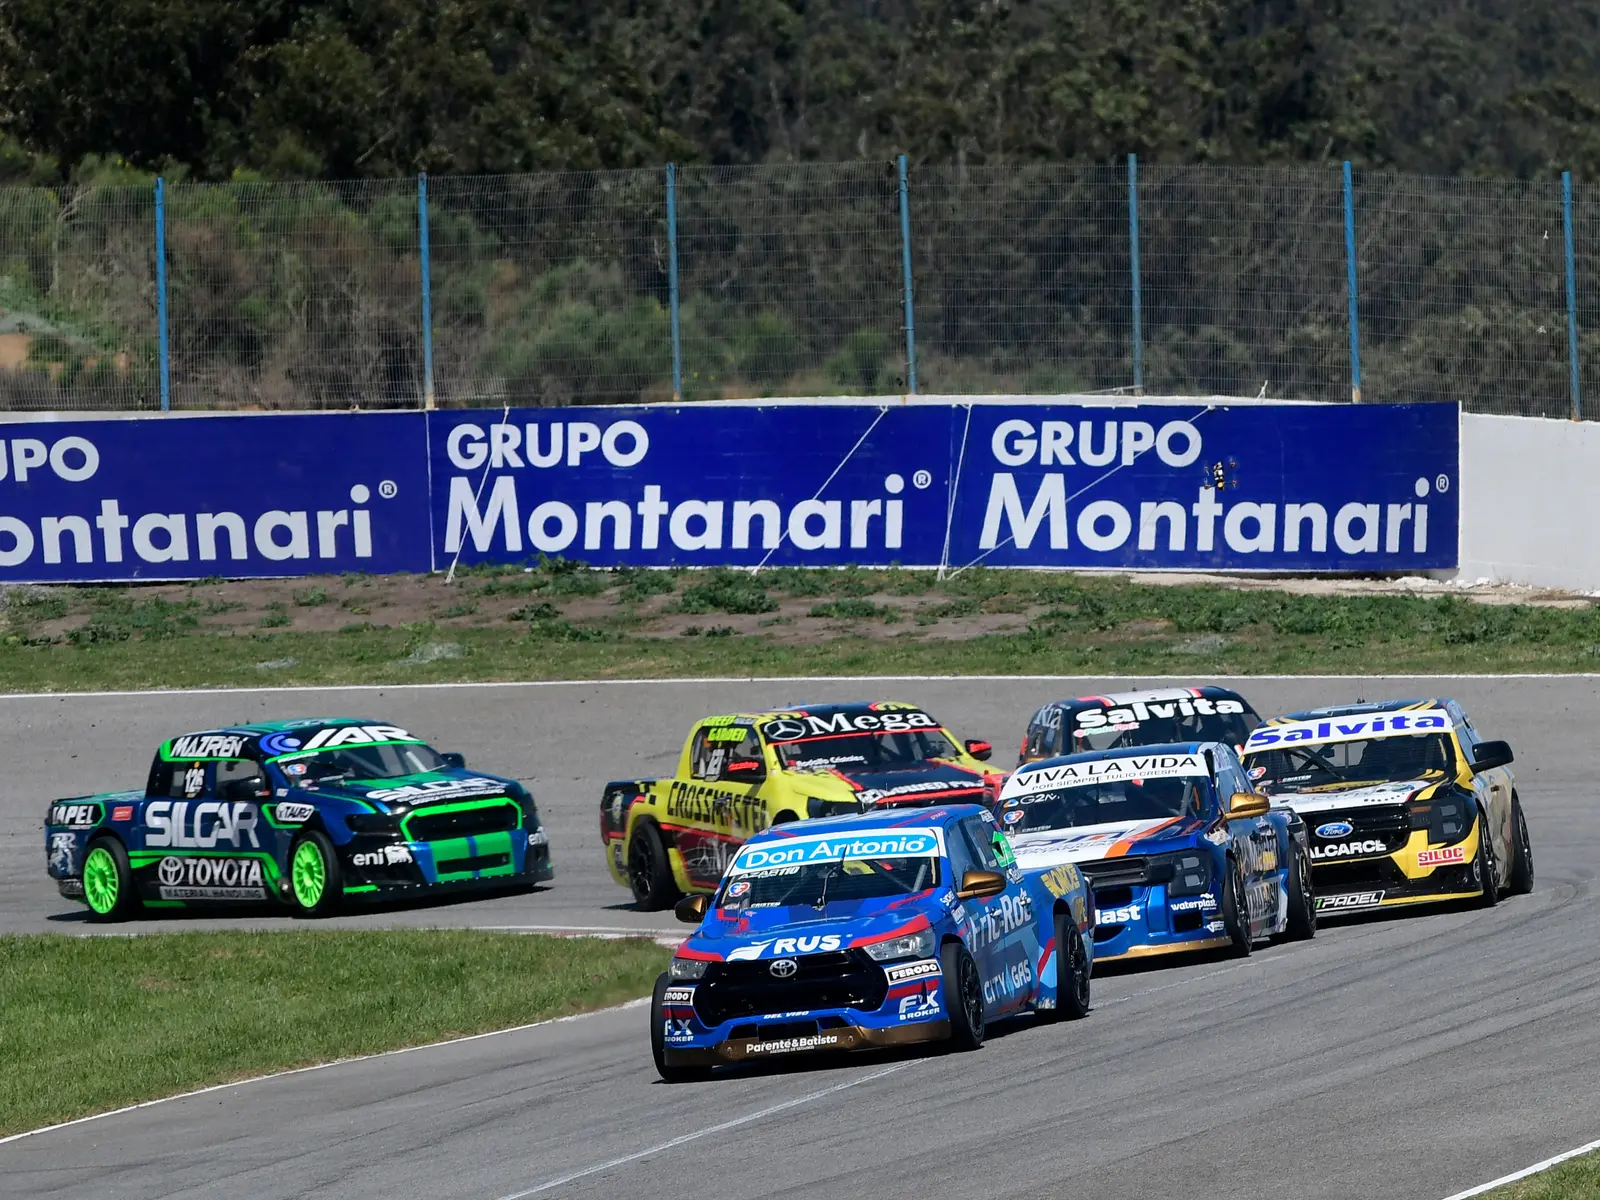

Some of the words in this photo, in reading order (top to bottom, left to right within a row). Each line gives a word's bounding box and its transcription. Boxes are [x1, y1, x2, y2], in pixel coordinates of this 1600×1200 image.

[446, 420, 649, 470] GRUPO
[991, 420, 1201, 468] GRUPO
[0, 436, 99, 482] PO
[444, 473, 903, 554] Montanari
[978, 472, 1429, 554] Montanari
[807, 712, 938, 736] Mega
[1075, 698, 1244, 729] Salvita
[1250, 715, 1445, 747] Salvita
[1016, 767, 1083, 787] VIVA
[1088, 761, 1123, 776] LA
[1131, 757, 1198, 770] VIDA
[1031, 782, 1054, 791] POR
[1056, 776, 1100, 788] SIEMPRE
[1104, 771, 1137, 781] TULIO
[1138, 768, 1178, 777] CRESPI
[145, 801, 260, 848] SILCAR
[1323, 825, 1345, 836] Ford
[353, 848, 384, 866] eni
[745, 847, 803, 869] Don
[809, 837, 925, 859] Antonio
[1418, 847, 1465, 862] SILOC
[185, 858, 264, 886] TOYOTA
[1170, 898, 1217, 911] waterplast
[774, 934, 842, 955] RUS
[891, 963, 938, 980] FERODO
[984, 971, 1007, 1004] CITY
[1011, 959, 1032, 989] GAS
[763, 1012, 783, 1020] DEL
[786, 1010, 810, 1018] VISO
[899, 1007, 940, 1020] BROKER
